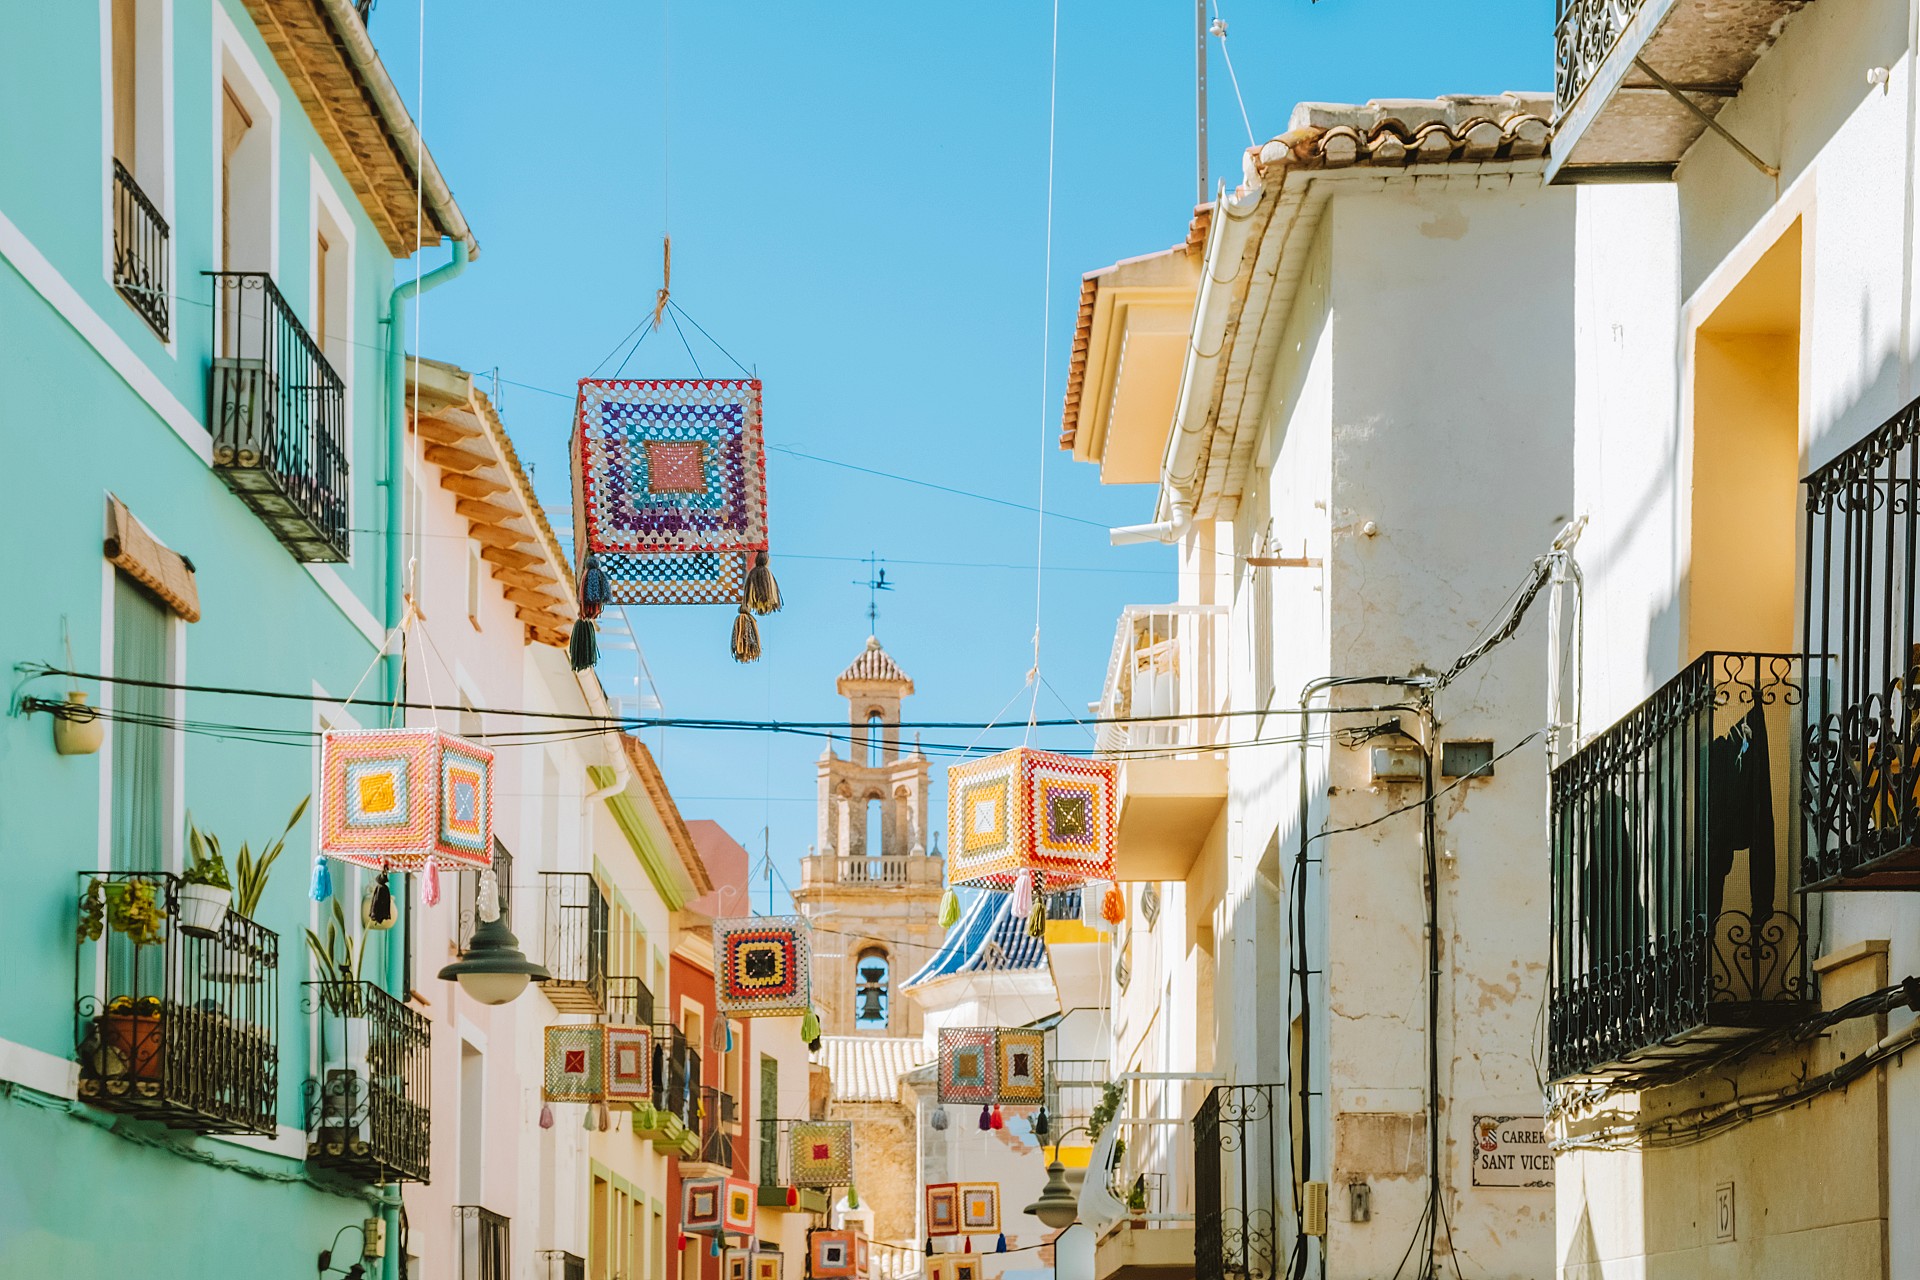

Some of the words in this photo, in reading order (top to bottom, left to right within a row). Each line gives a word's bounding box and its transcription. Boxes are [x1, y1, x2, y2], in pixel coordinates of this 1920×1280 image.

[1502, 1130, 1546, 1144] CARRER
[1482, 1154, 1515, 1170] SANT
[1719, 1193, 1729, 1231] 15
